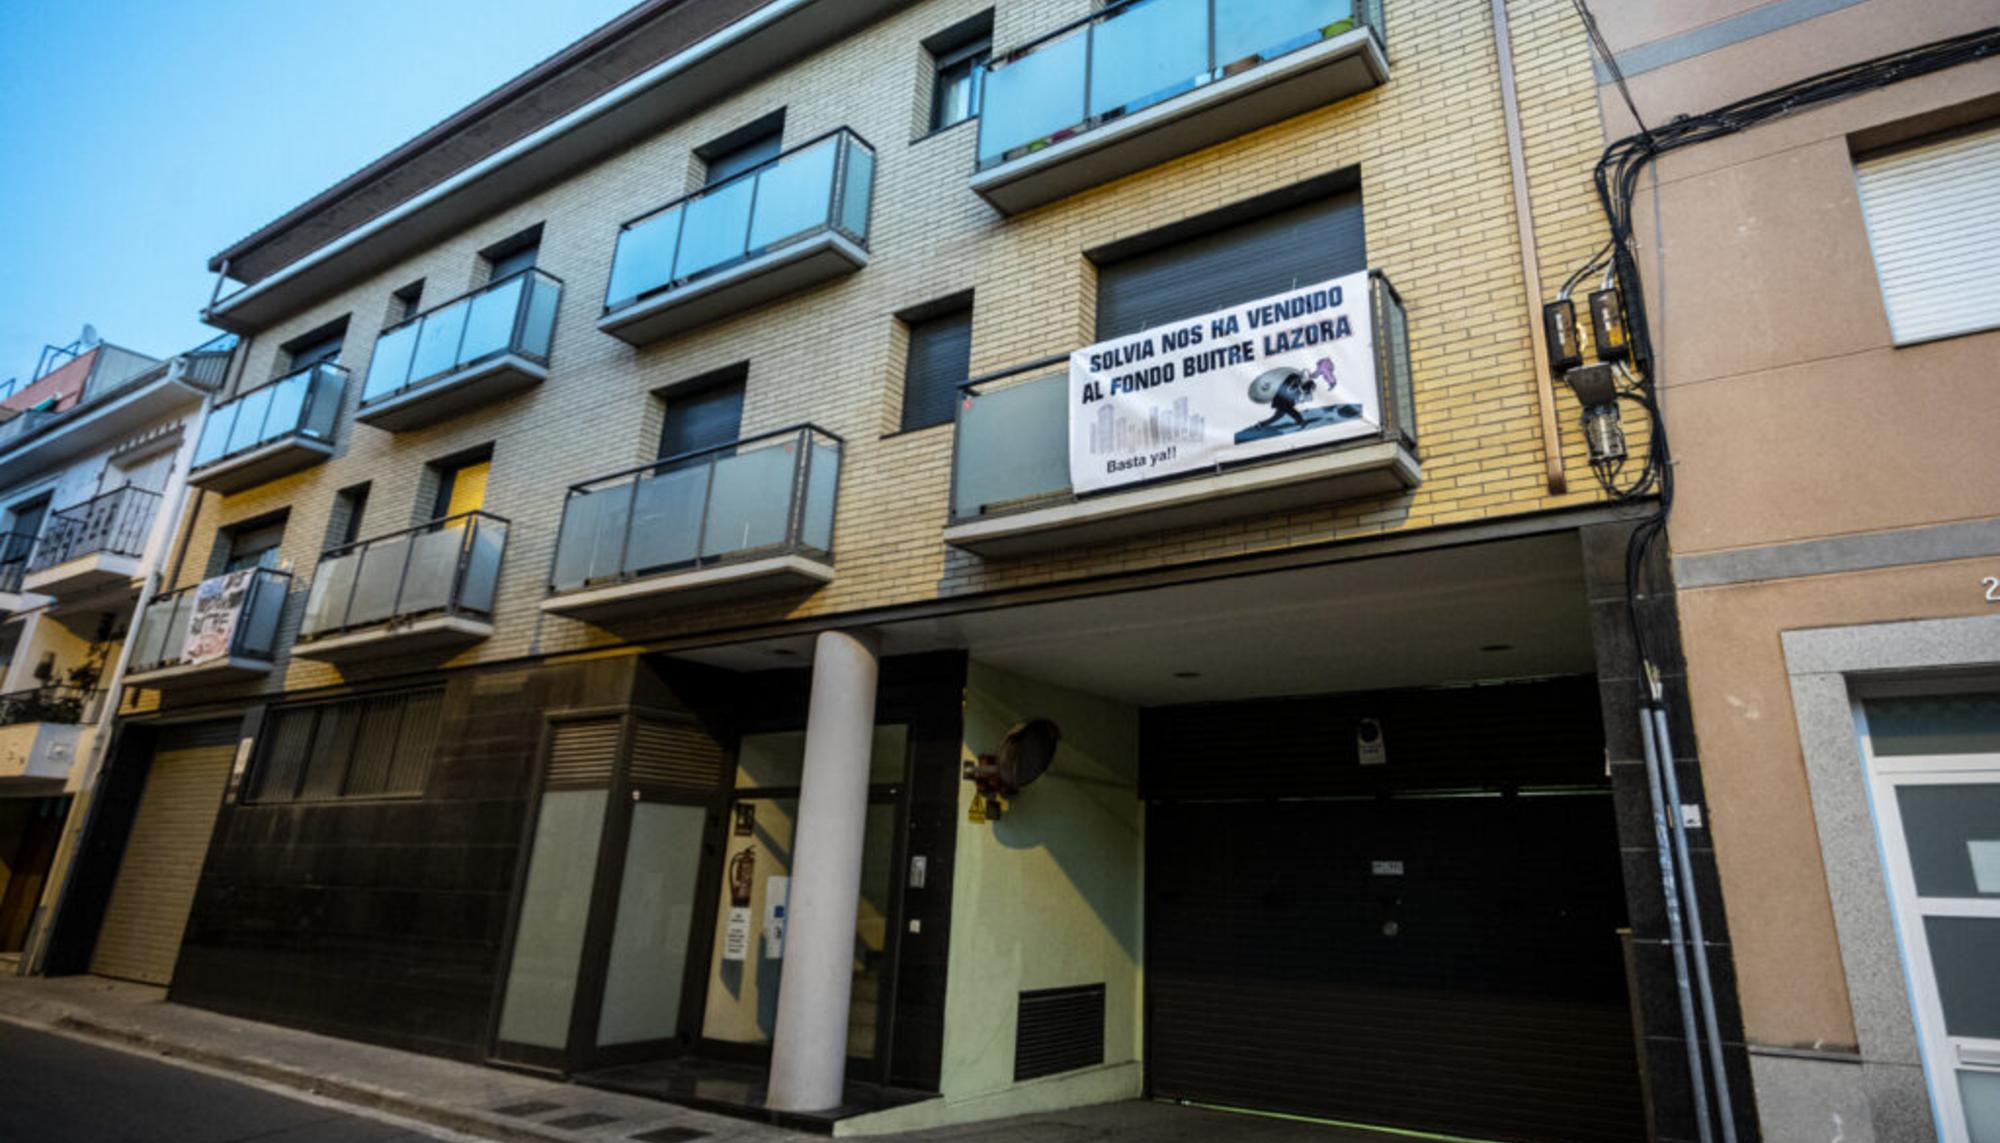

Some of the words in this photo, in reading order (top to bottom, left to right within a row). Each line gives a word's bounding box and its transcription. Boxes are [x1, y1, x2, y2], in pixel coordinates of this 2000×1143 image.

[1082, 381, 1104, 404] AL
[1110, 362, 1175, 396] FONDO
[1183, 341, 1254, 377] BUITRE
[1264, 315, 1352, 356] LAZORA
[1089, 339, 1154, 373] SOLVIA
[1162, 325, 1202, 353] NOS
[1211, 314, 1239, 338] HA
[1247, 286, 1343, 328] VENDIDO
[1107, 456, 1147, 473] Basta
[1150, 445, 1177, 467] ya!!
